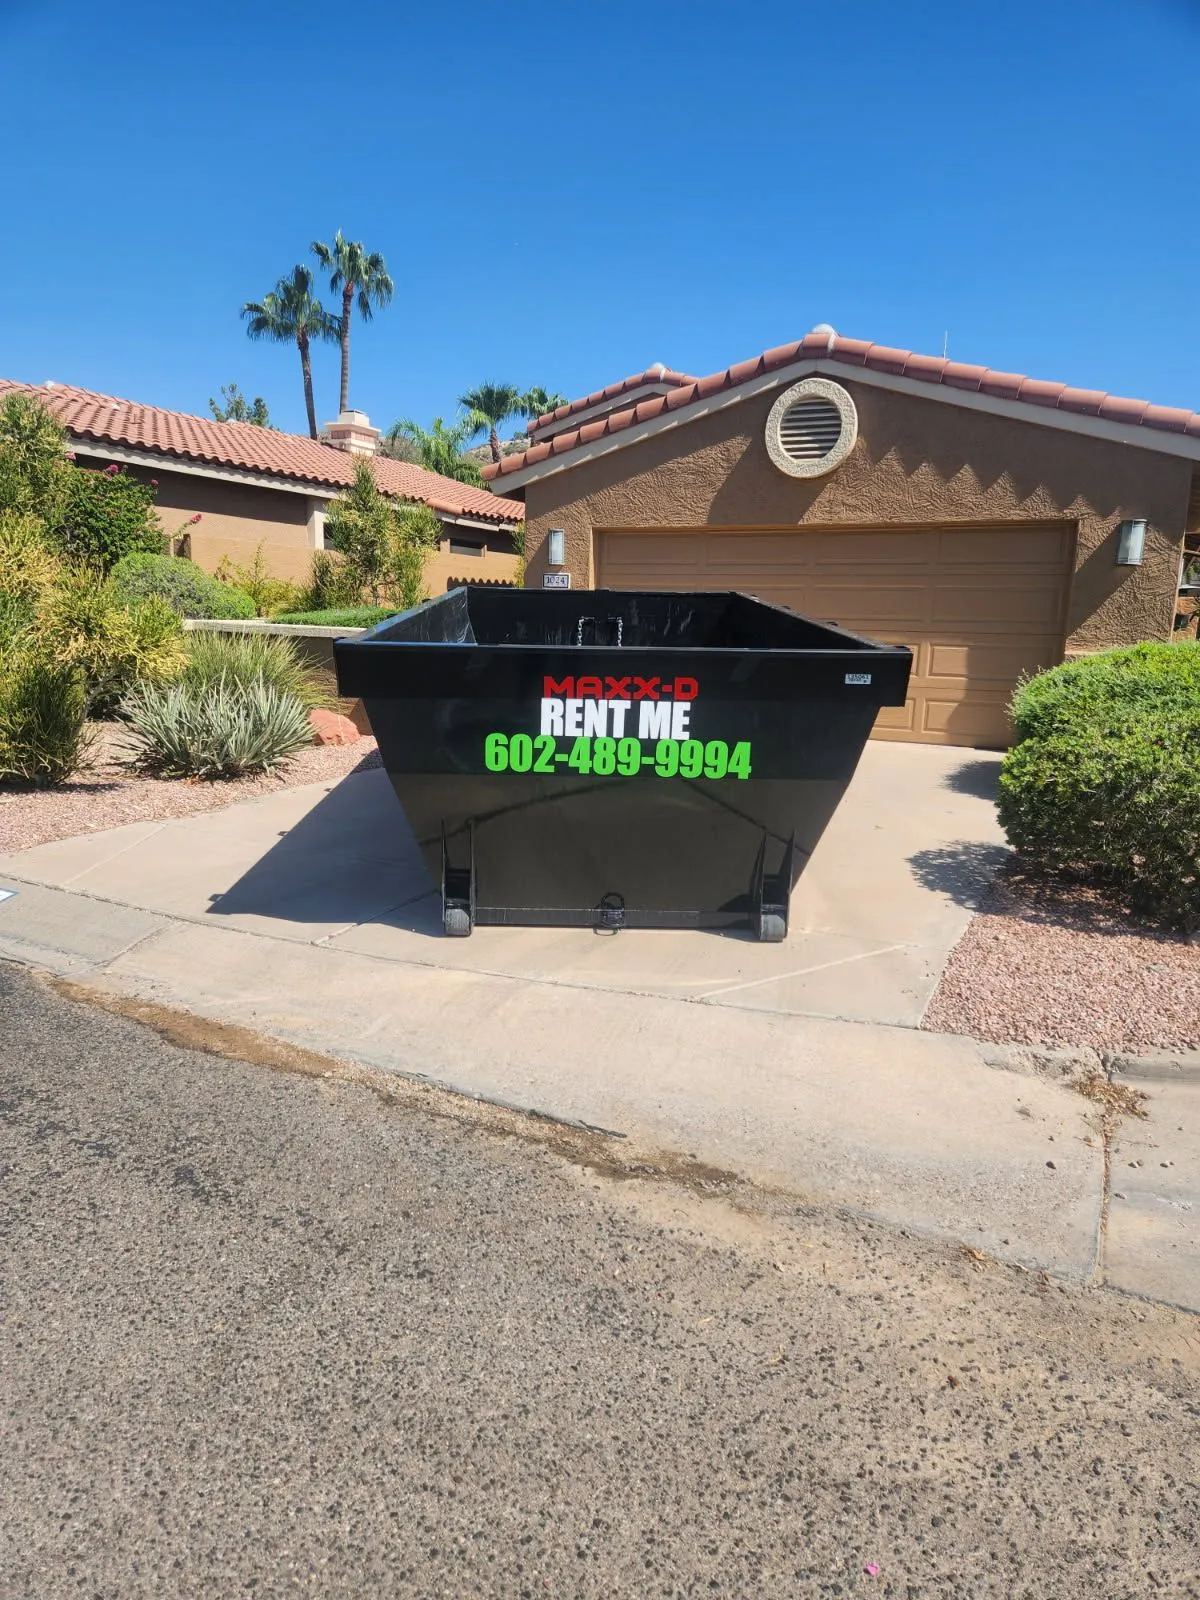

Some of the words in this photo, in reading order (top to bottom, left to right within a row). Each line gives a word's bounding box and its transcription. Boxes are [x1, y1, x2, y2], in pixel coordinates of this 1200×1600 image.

[546, 576, 565, 585] 1024
[543, 676, 699, 700] MAXX-D
[540, 698, 631, 739] RENT
[638, 701, 691, 741] ME
[485, 733, 752, 779] 602-489-9994
